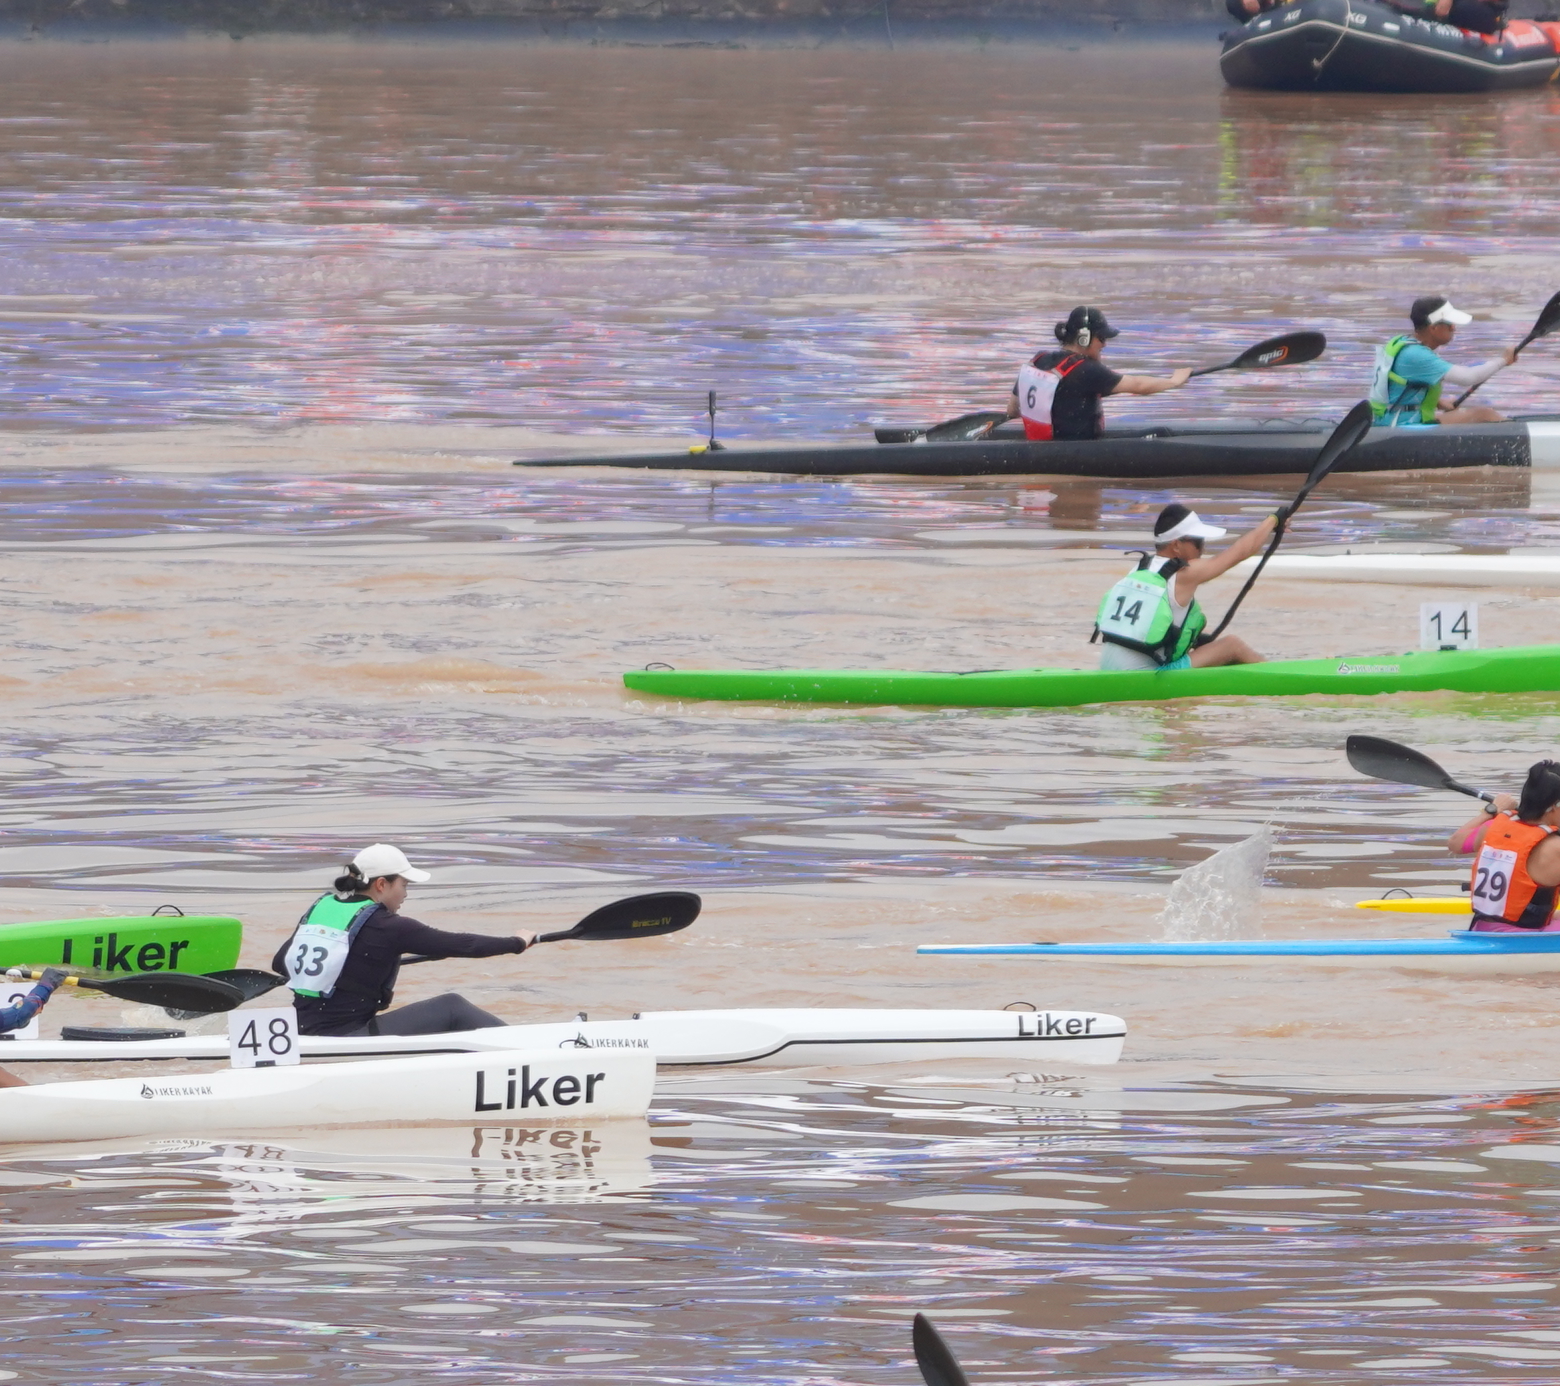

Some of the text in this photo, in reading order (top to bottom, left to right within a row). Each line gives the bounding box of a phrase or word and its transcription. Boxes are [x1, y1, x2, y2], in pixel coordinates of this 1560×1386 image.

[1026, 385, 1037, 410] 6
[1109, 595, 1144, 626] 14
[1430, 610, 1472, 641] 14
[1472, 866, 1508, 902] 29
[62, 932, 190, 973] Liker
[293, 953, 329, 977] 33
[238, 1017, 292, 1057] 48
[1018, 1015, 1098, 1038] Liker
[474, 1067, 605, 1114] Liker
